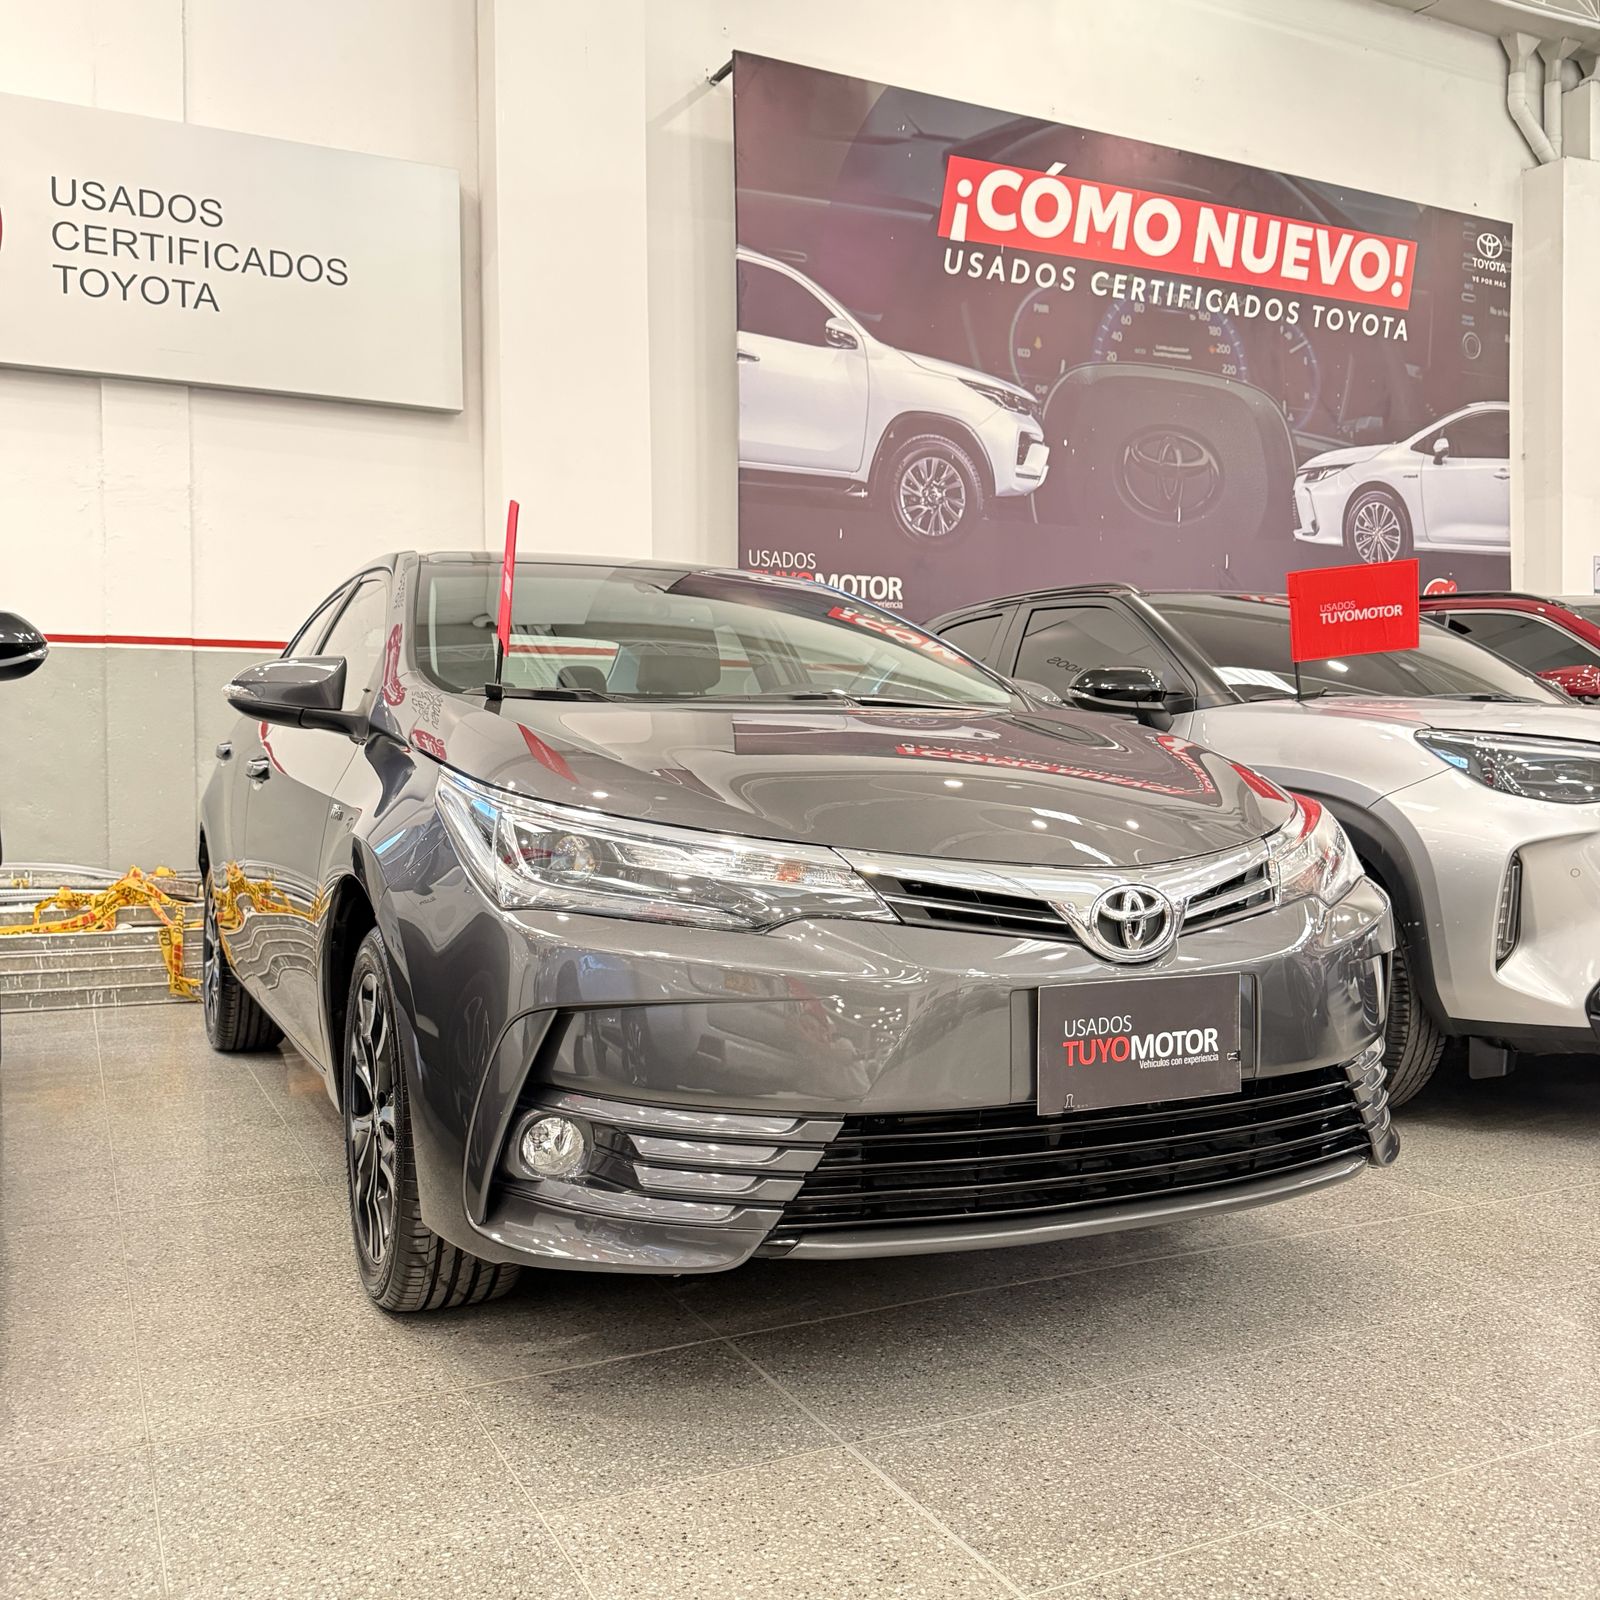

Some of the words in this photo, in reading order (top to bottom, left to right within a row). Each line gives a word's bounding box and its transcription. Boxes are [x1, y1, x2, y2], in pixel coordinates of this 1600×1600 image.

[50, 176, 223, 228] USADOS
[949, 161, 1183, 258] ¡CÓMO
[1192, 206, 1409, 298] NUEVO!
[51, 221, 349, 286] CERTIFICADOS
[1471, 257, 1507, 274] TOYOTA
[52, 264, 221, 313] TOYOTA
[1480, 277, 1494, 286] POR
[943, 247, 1077, 292] USADOS
[1090, 271, 1300, 325] CERTIFICADOS
[1312, 304, 1409, 342] TOYOTA
[748, 549, 817, 570] USADOS
[1319, 600, 1356, 613] USADOS
[1319, 604, 1402, 624] TUYOMOTOR
[1063, 1014, 1133, 1038] USADOS
[1062, 1028, 1219, 1067] TUYOMOTOR
[1170, 1057, 1183, 1066] con
[1183, 1053, 1219, 1066] experiencia
